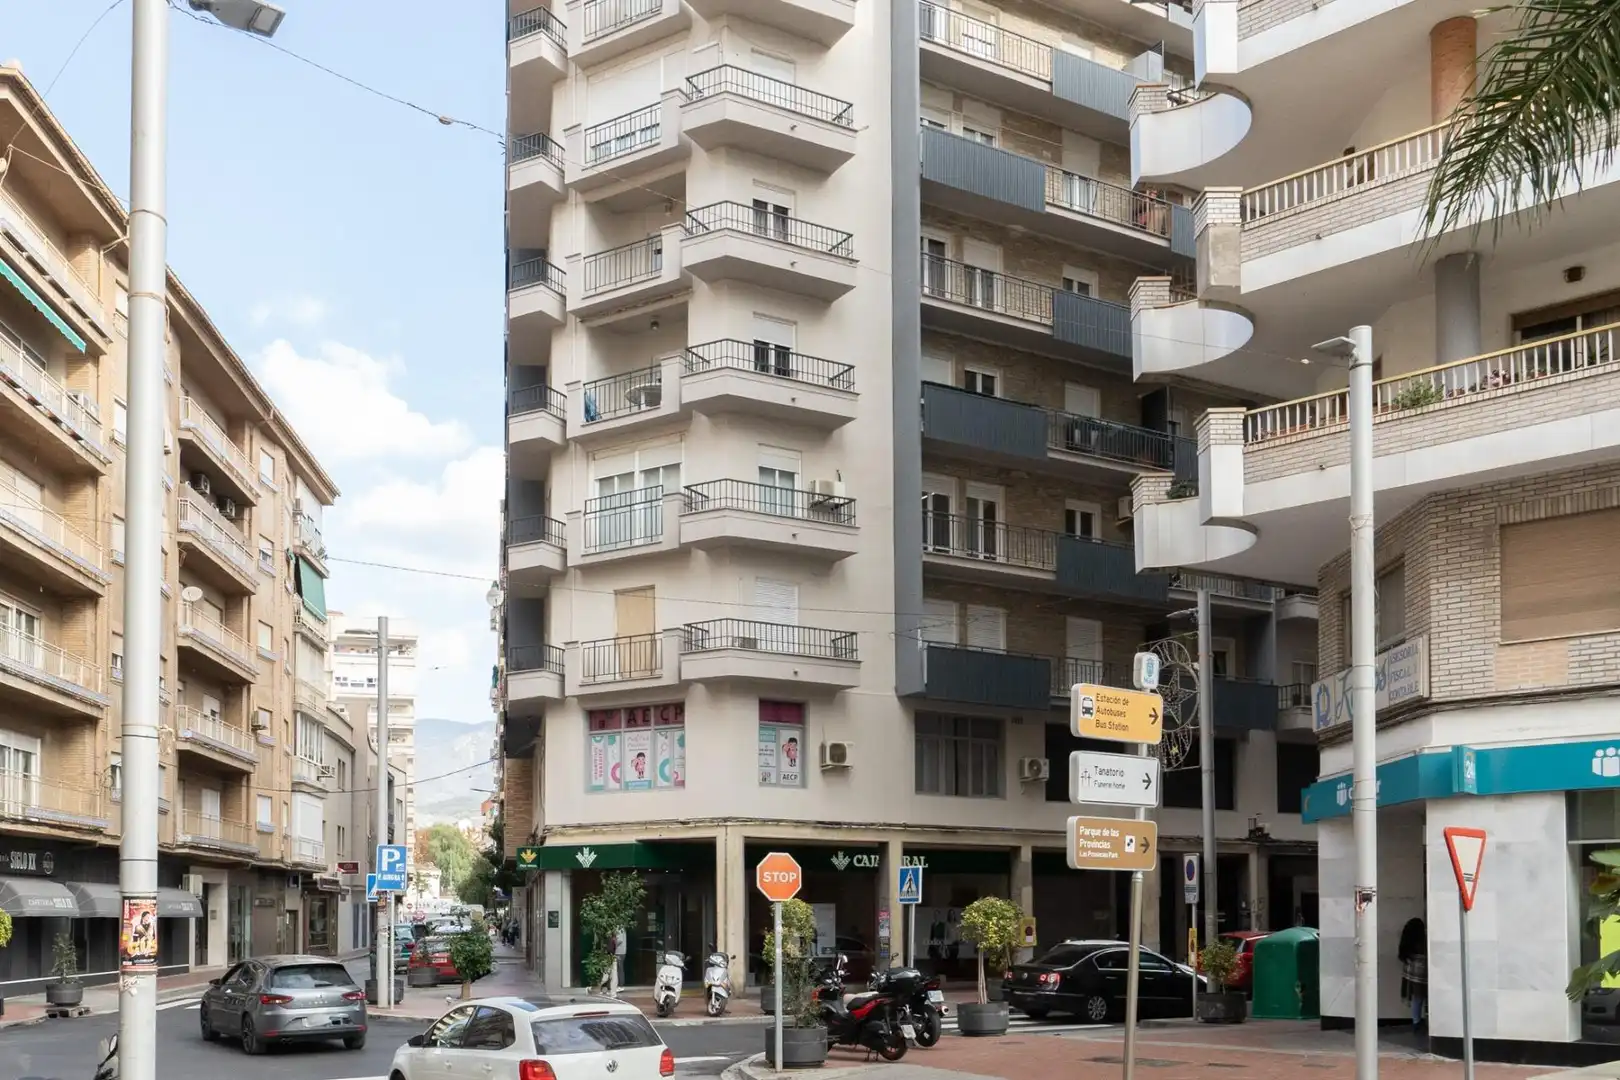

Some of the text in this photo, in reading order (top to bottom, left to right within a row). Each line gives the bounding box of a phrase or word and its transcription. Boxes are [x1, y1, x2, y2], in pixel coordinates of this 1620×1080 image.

[1122, 698, 1130, 706] de
[1096, 706, 1126, 718] Autobuses
[1095, 720, 1129, 732] Bus Station
[1094, 765, 1125, 777] Tanatorio
[1080, 826, 1120, 838] Parque de las
[1079, 838, 1111, 849] Provincias
[381, 848, 400, 872] P
[762, 871, 797, 884] STOP
